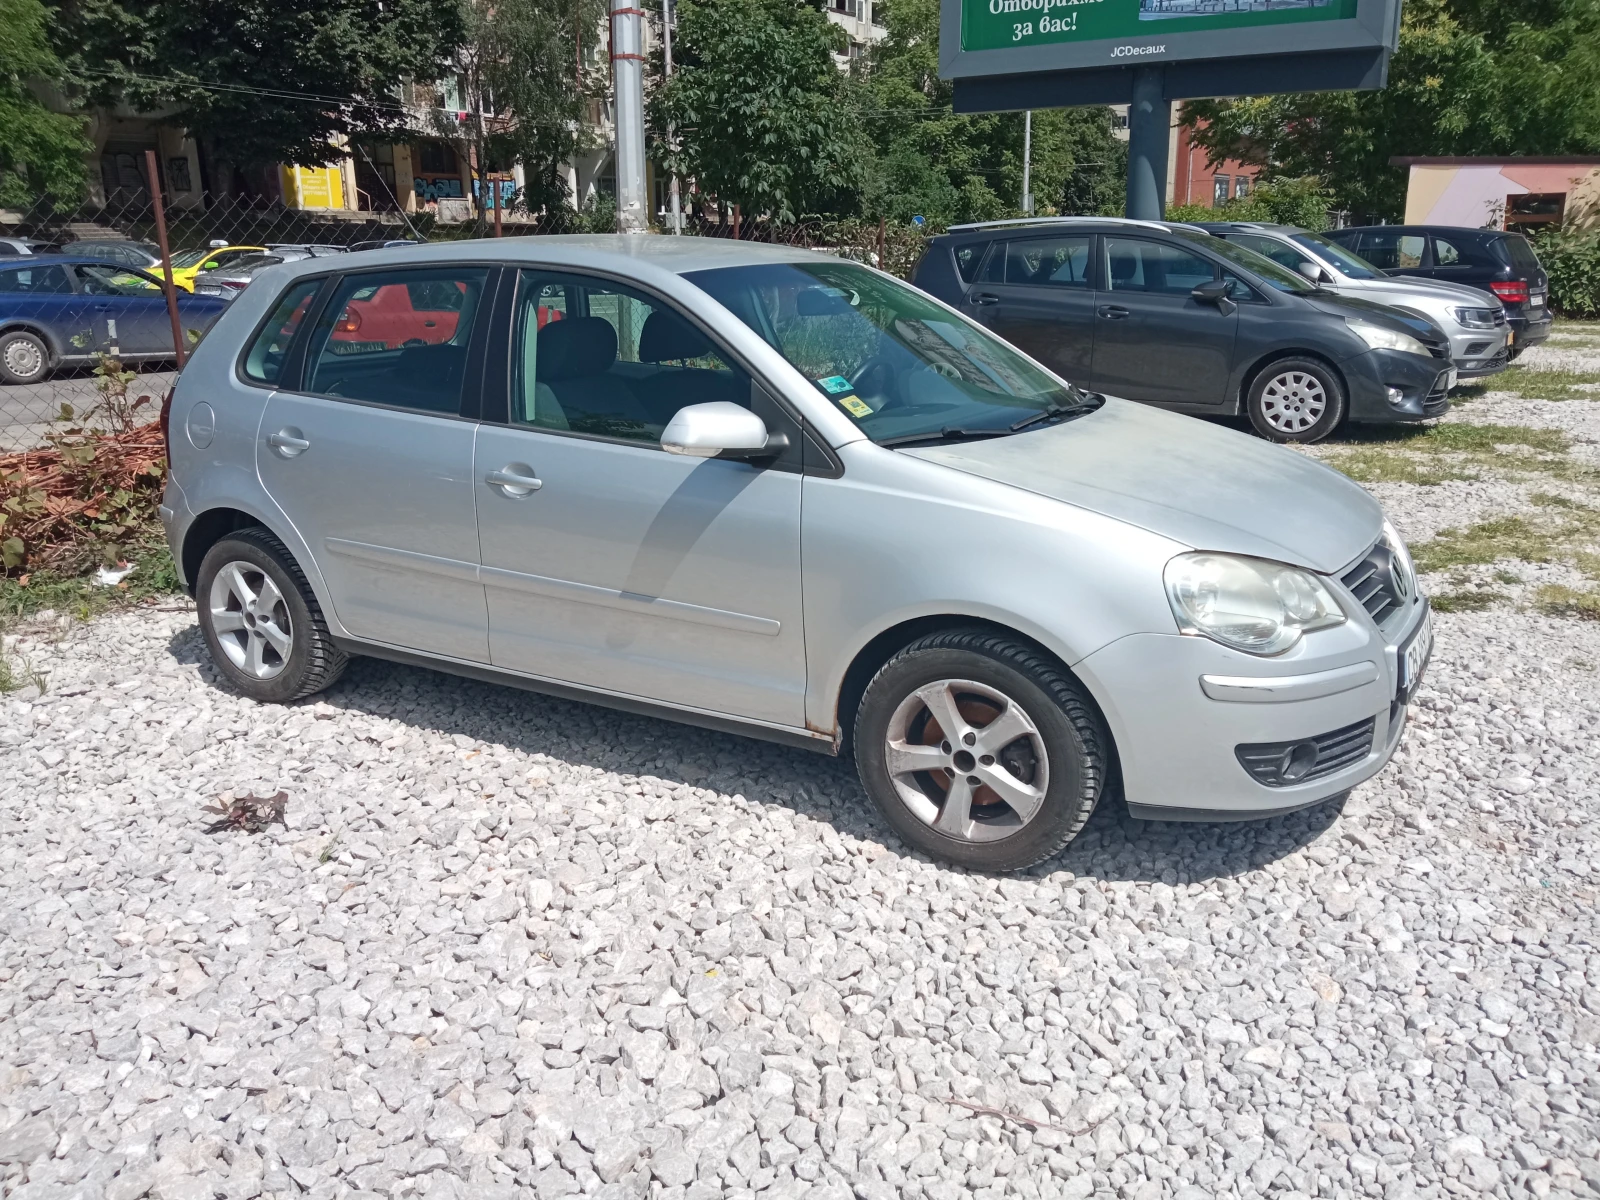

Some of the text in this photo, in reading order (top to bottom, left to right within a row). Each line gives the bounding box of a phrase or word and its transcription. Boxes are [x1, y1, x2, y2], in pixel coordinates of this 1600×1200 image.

[989, 0, 1104, 14] Отвори
[1012, 12, 1078, 41] за вас!
[1110, 44, 1167, 58] JCDecaux
